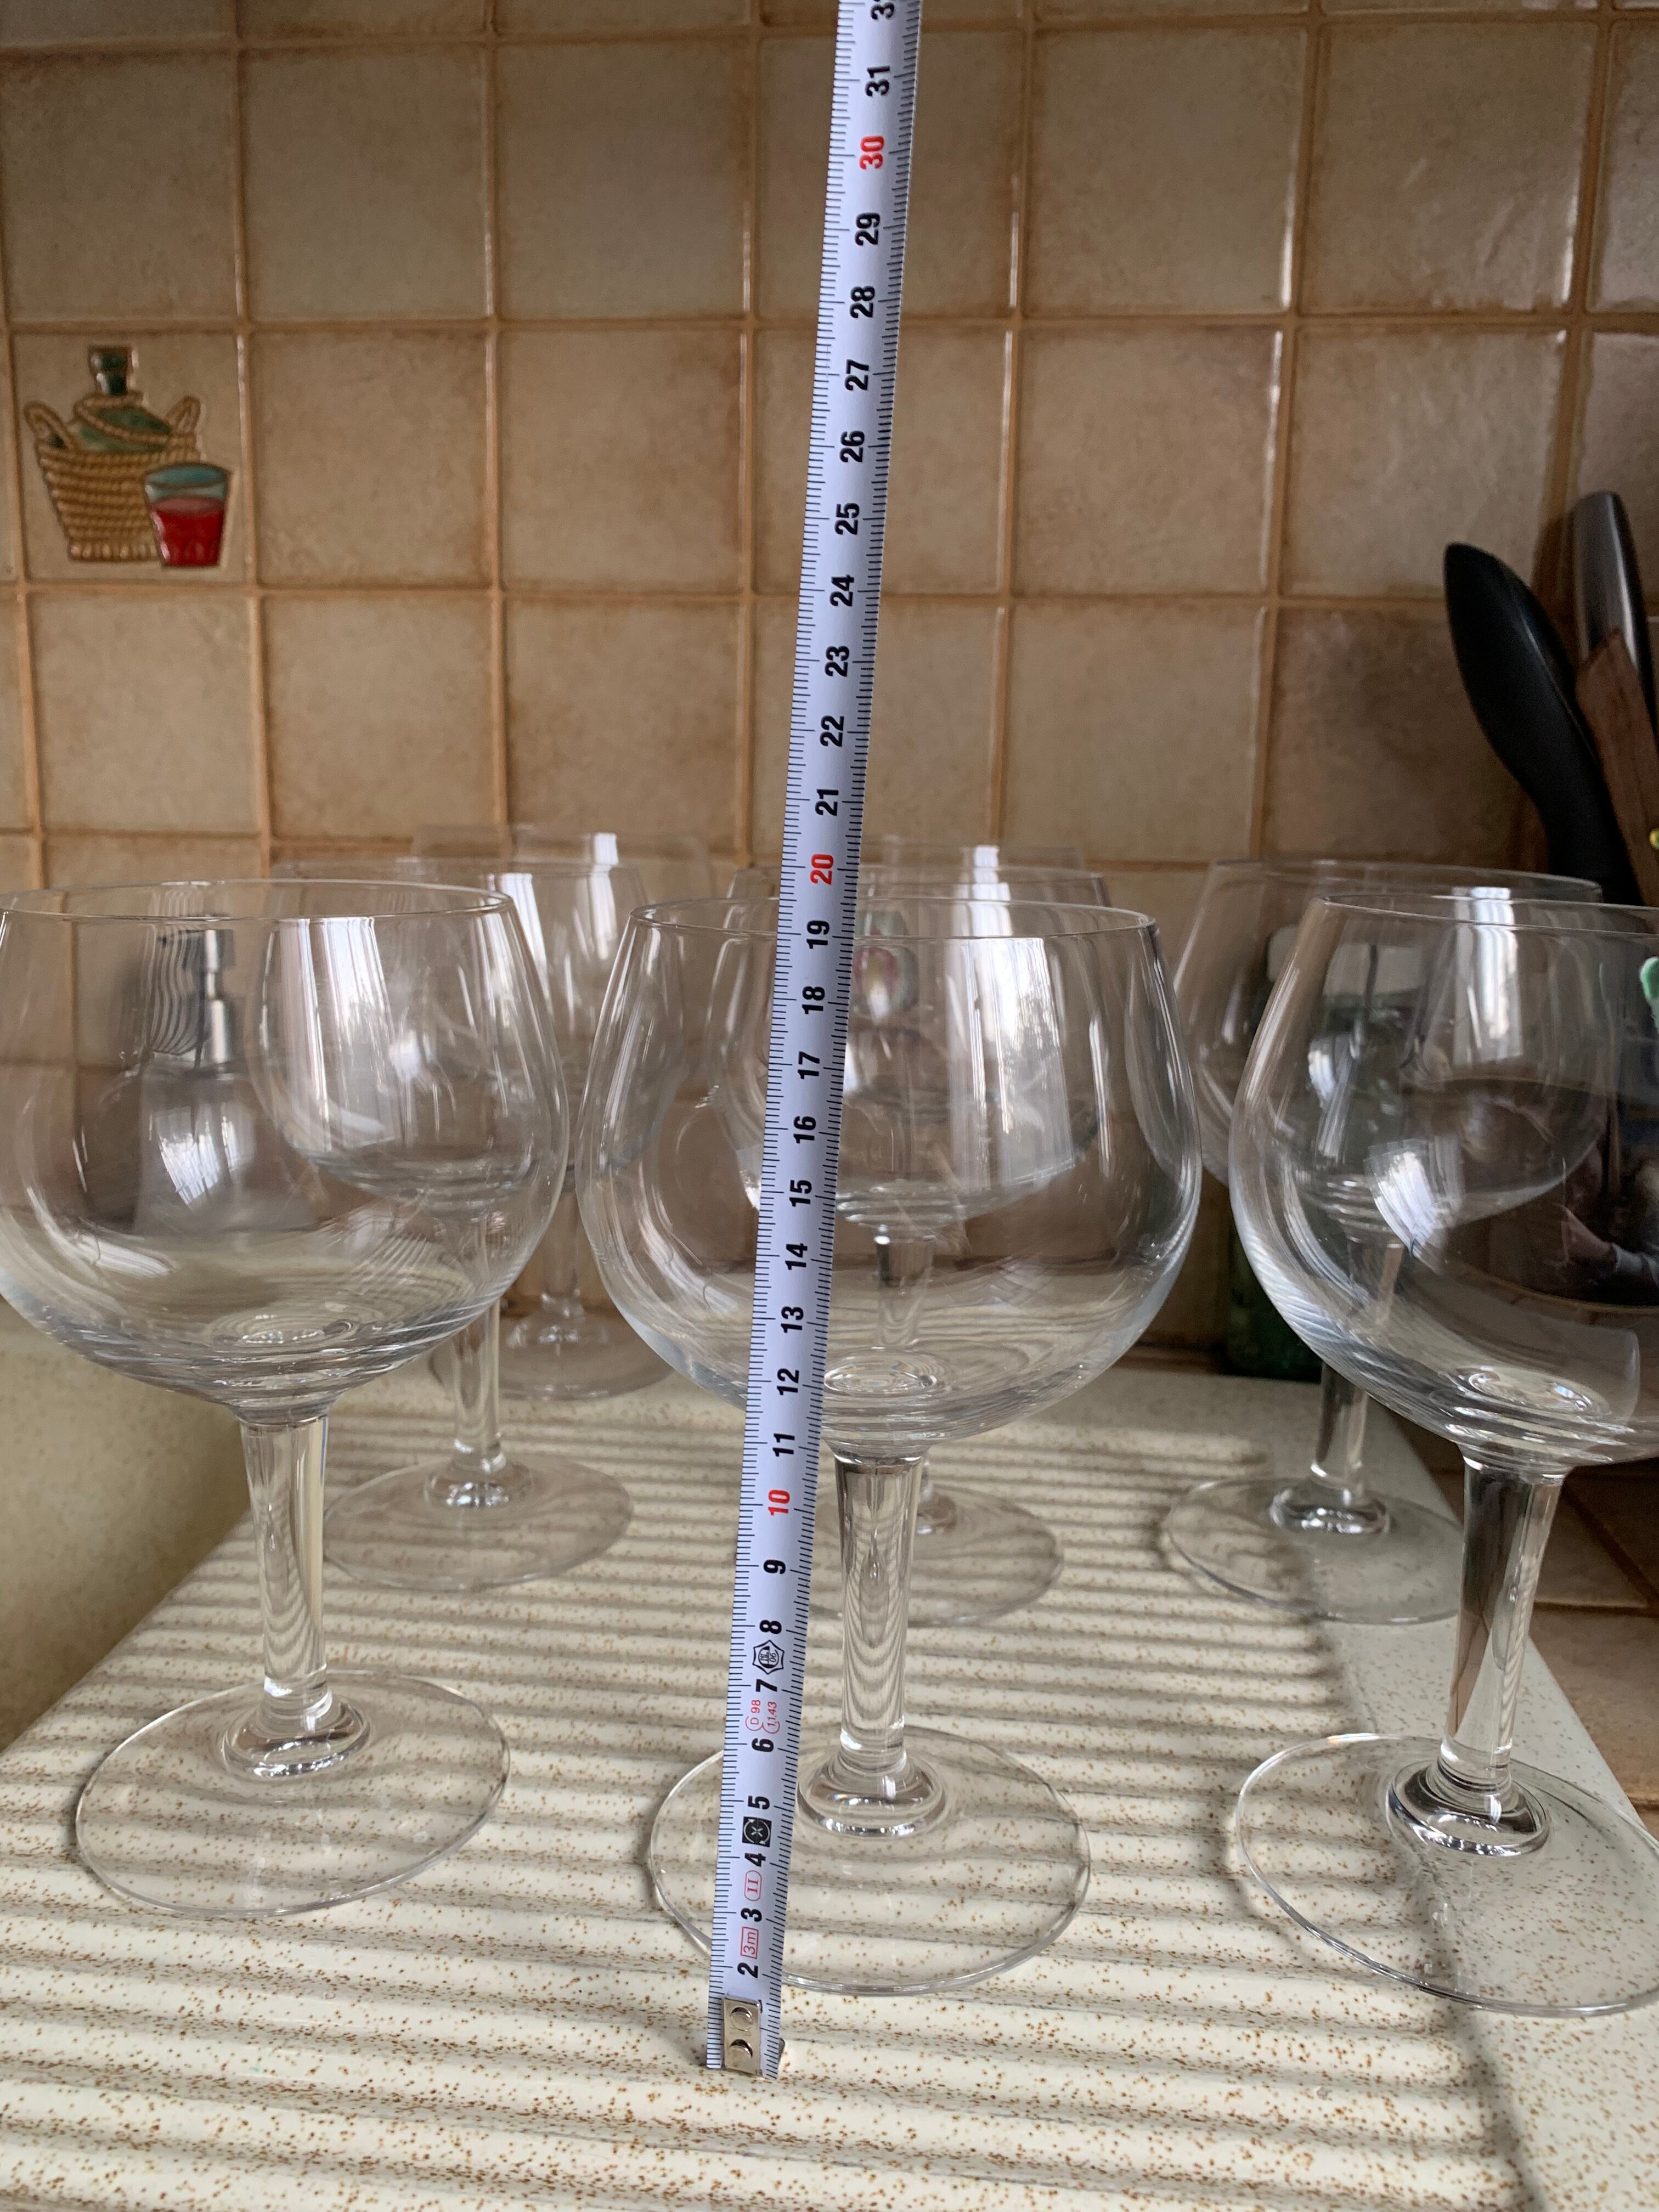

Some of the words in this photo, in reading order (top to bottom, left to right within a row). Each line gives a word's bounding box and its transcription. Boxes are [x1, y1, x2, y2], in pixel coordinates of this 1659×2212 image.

[870, 0, 895, 20] 3
[865, 65, 890, 97] 31
[860, 136, 885, 170] 30
[854, 212, 882, 246] 29
[849, 285, 877, 319] 28
[844, 359, 871, 392] 27
[839, 430, 866, 463] 26
[834, 503, 860, 536] 25
[830, 574, 855, 608] 24
[824, 645, 852, 678] 23
[820, 715, 845, 747] 22
[815, 788, 840, 816] 21
[810, 853, 835, 885] 20
[806, 920, 831, 949] 19
[802, 985, 826, 1014] 18
[797, 1051, 821, 1080] 17
[793, 1115, 817, 1144] 16
[788, 1180, 813, 1207] 15
[785, 1243, 808, 1271] 14
[780, 1306, 804, 1334] 13
[776, 1368, 800, 1396] 12
[772, 1433, 795, 1457] 11
[768, 1489, 791, 1516] 10
[763, 1559, 786, 1575] 9
[759, 1620, 782, 1635] 8
[755, 1679, 778, 1692] 7
[751, 1700, 760, 1713] 98
[751, 1737, 775, 1753] 6
[747, 1795, 770, 1810] 5
[744, 1853, 766, 1867] 4
[741, 1908, 763, 1922] 3
[743, 1931, 756, 1955] 3m
[737, 1965, 759, 1978] 2
